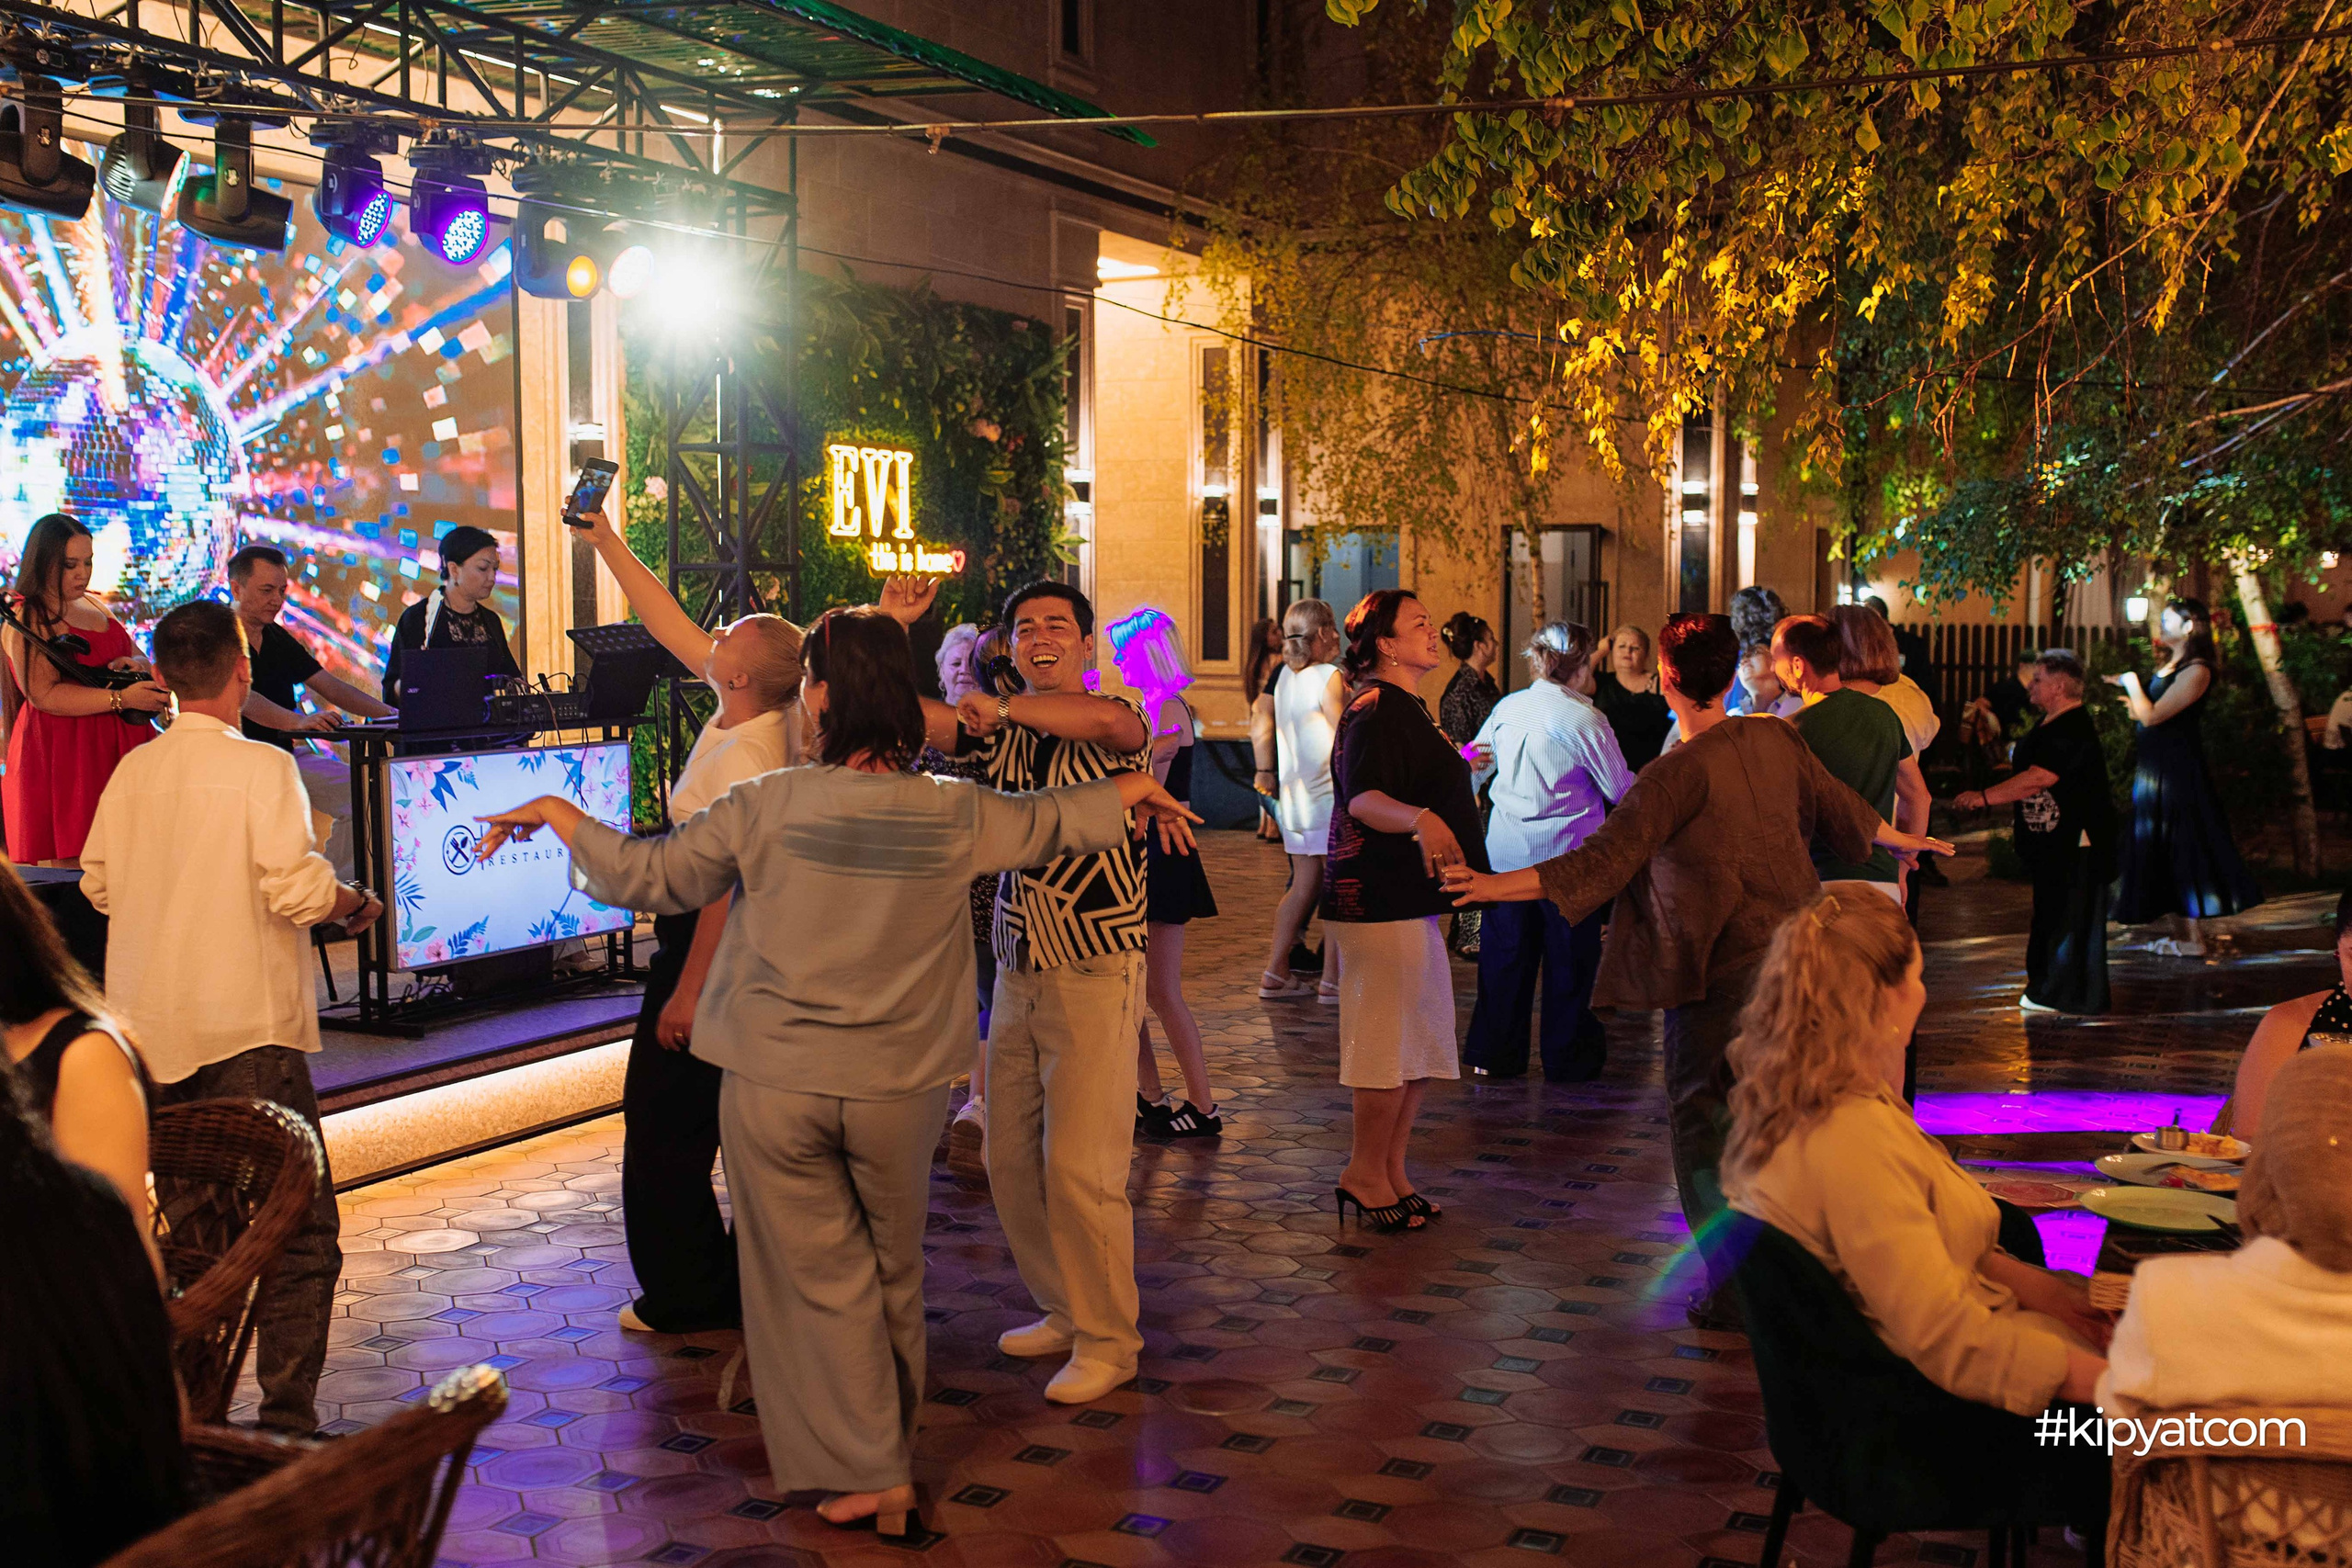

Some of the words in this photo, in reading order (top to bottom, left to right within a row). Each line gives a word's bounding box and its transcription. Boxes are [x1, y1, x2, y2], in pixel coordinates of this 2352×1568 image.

[829, 444, 914, 539] EVI
[869, 542, 898, 571] this
[899, 543, 914, 572] is
[488, 847, 565, 866] RESTAUR
